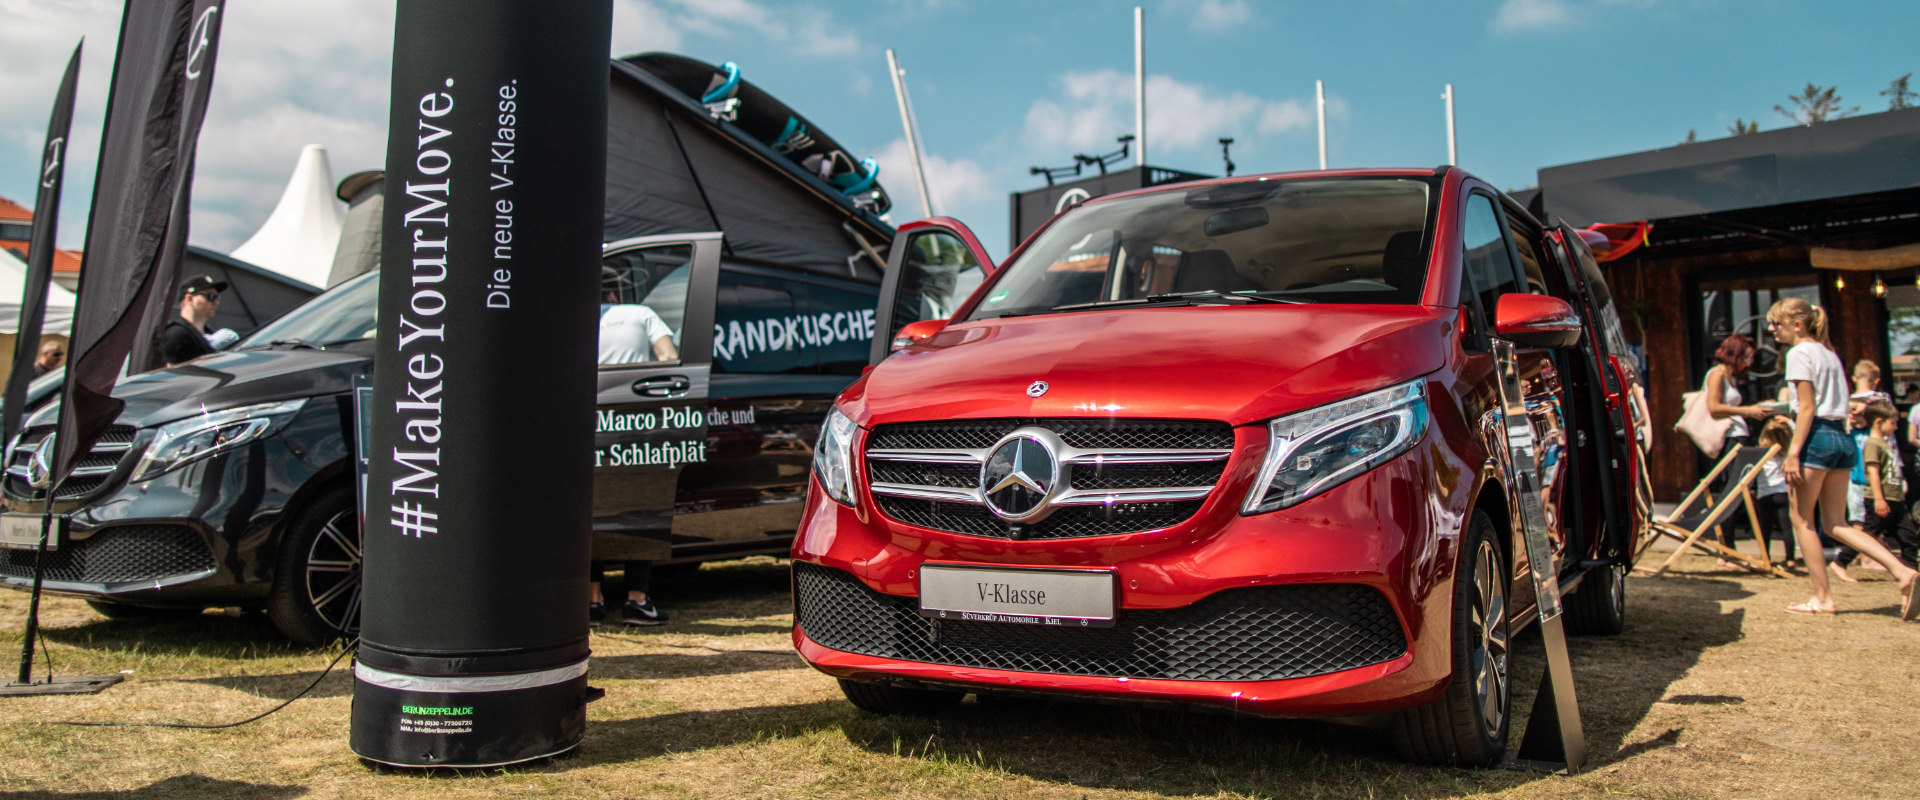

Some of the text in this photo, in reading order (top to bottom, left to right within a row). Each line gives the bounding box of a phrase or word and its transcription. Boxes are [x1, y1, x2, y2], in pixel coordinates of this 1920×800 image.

[486, 78, 518, 309] Die neue V-Klasse.
[390, 77, 455, 538] #MakeYourMove.
[595, 406, 704, 433] Marco Polo
[730, 404, 756, 426] und
[609, 440, 708, 470] Schlafplät
[976, 582, 1047, 606] V-Klasse
[402, 705, 474, 716] BERLINZEPPELIN.DE
